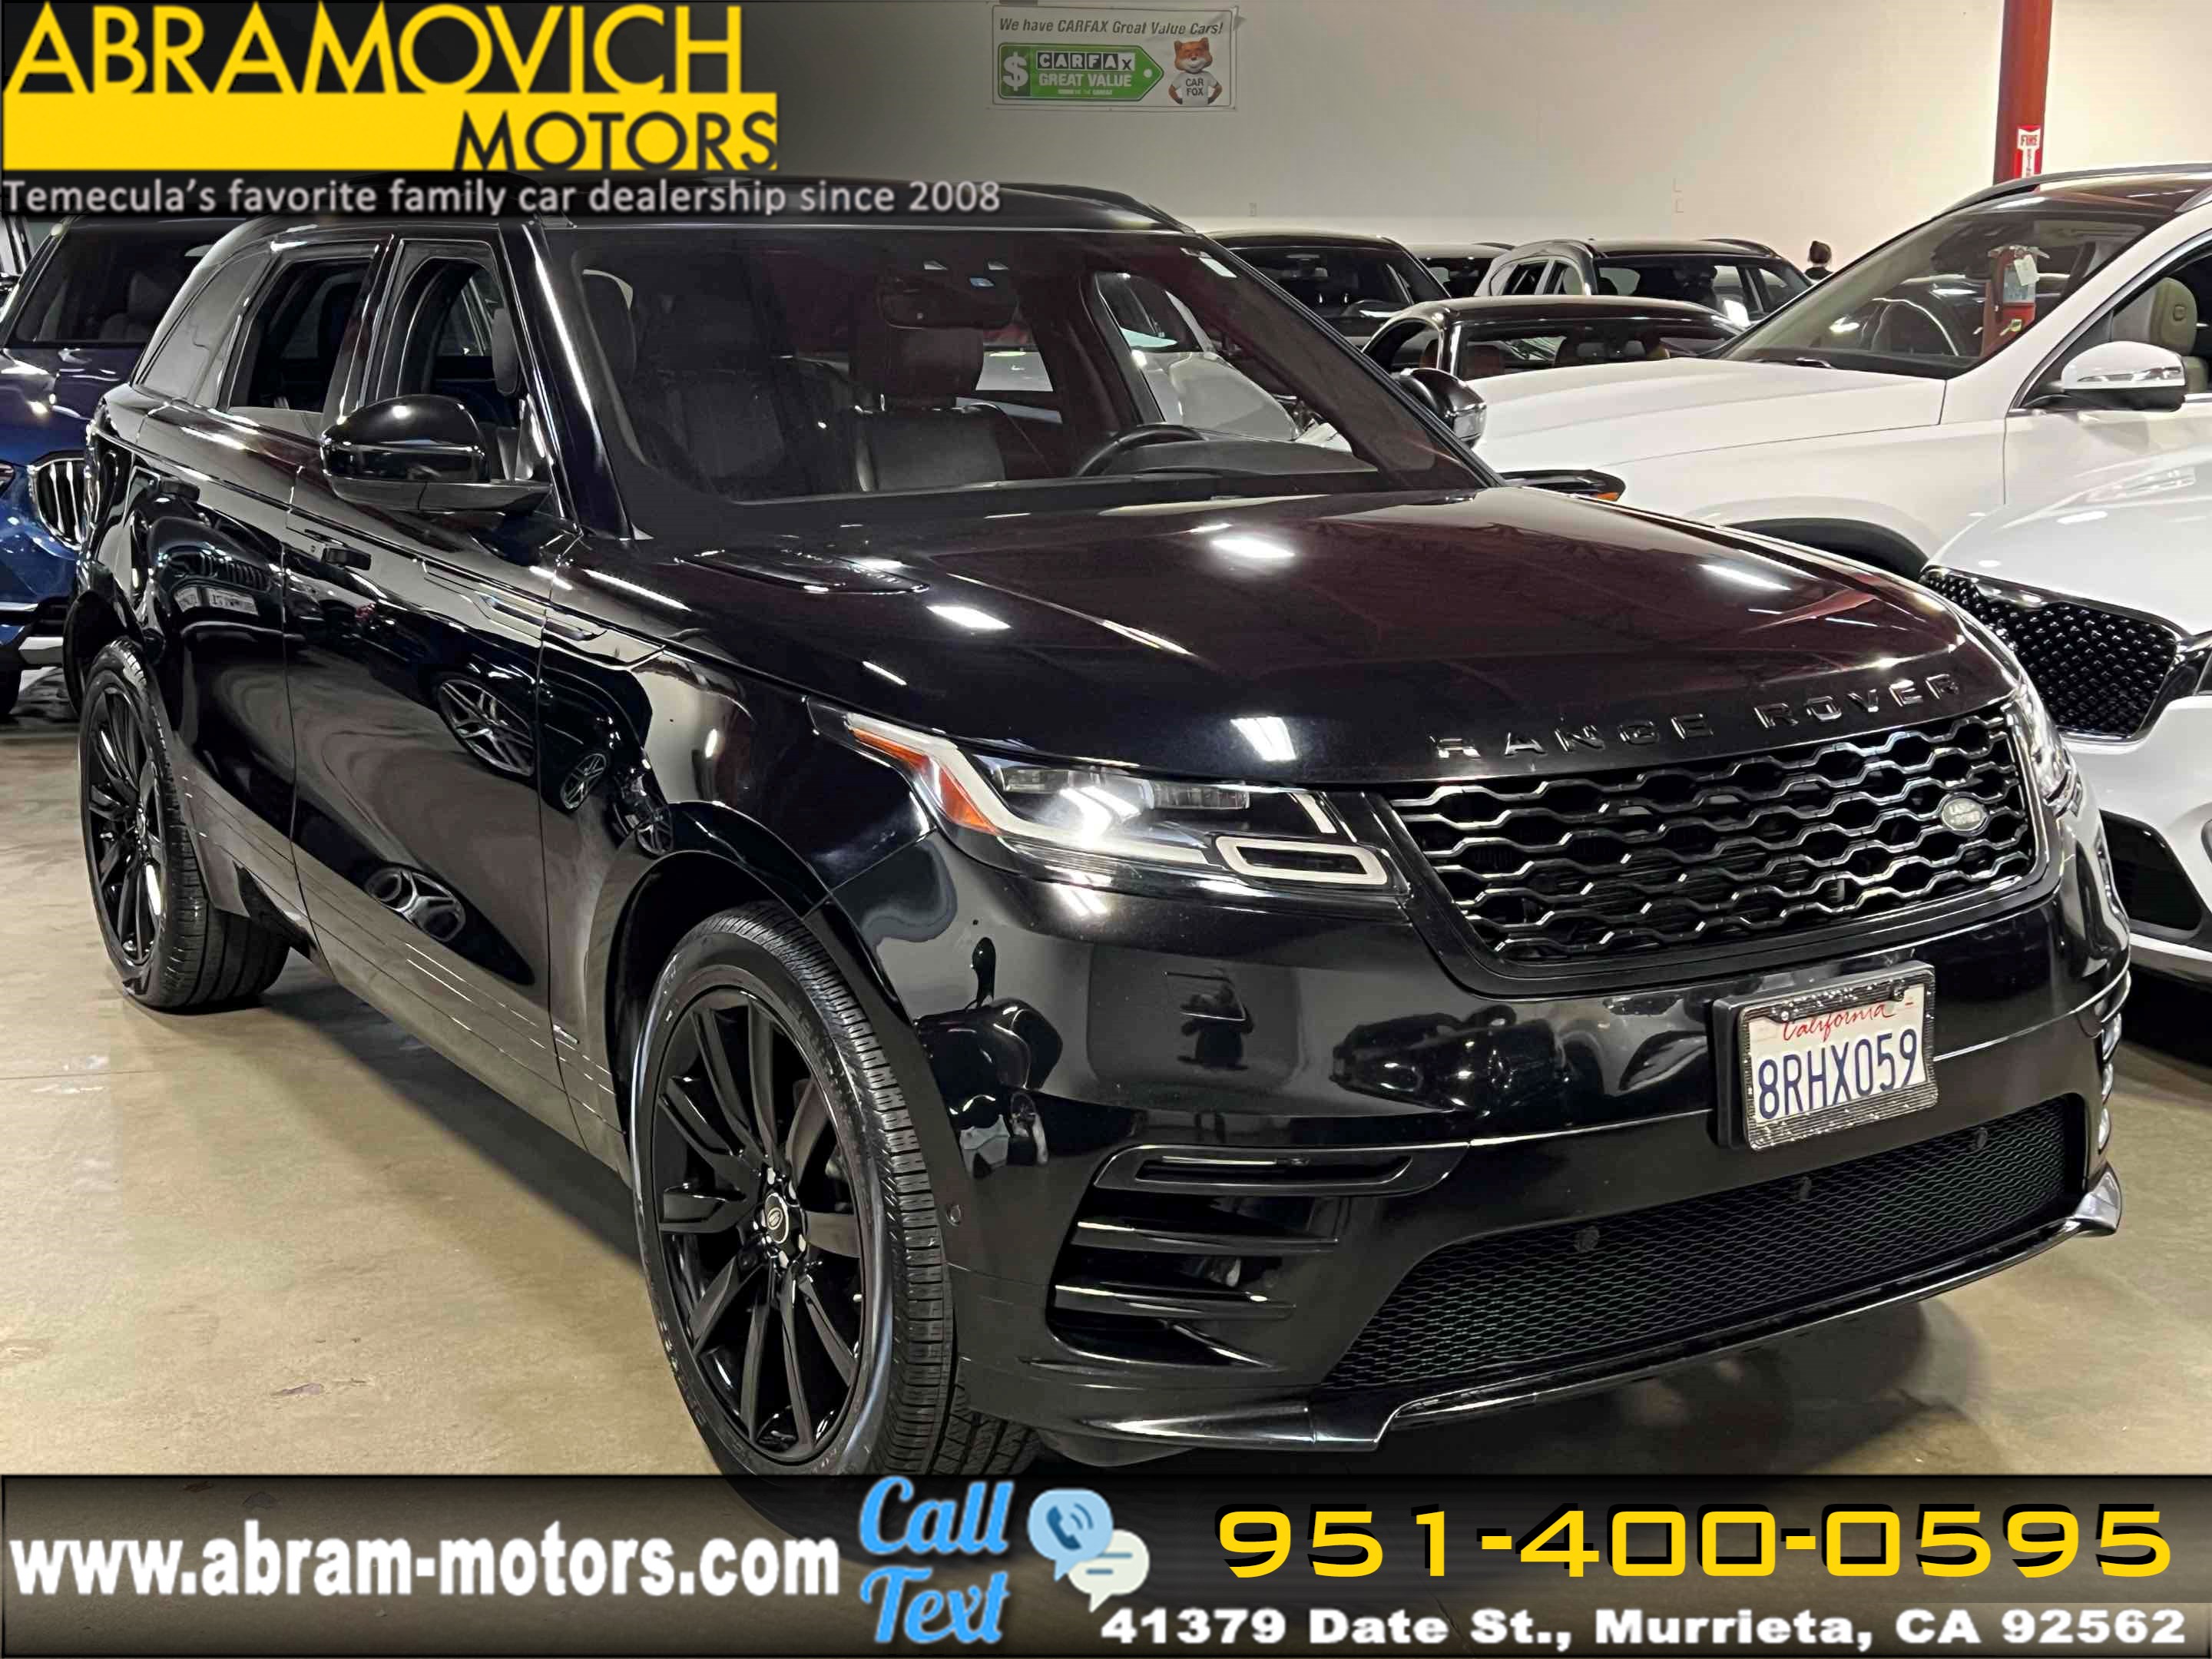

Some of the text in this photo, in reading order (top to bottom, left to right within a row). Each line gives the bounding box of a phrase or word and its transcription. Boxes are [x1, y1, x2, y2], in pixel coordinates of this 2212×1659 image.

[999, 18, 1224, 35] We have CARFAX Great Value Cars!
[1037, 52, 1135, 71] CARFAX
[1038, 73, 1132, 87] GREAT VALUE
[1185, 77, 1204, 87] CAR
[1186, 88, 1204, 97] FOX
[1429, 672, 1960, 760] RANGE ROVER
[1782, 1001, 1894, 1043] California
[1757, 1028, 1918, 1120] 8RHX059
